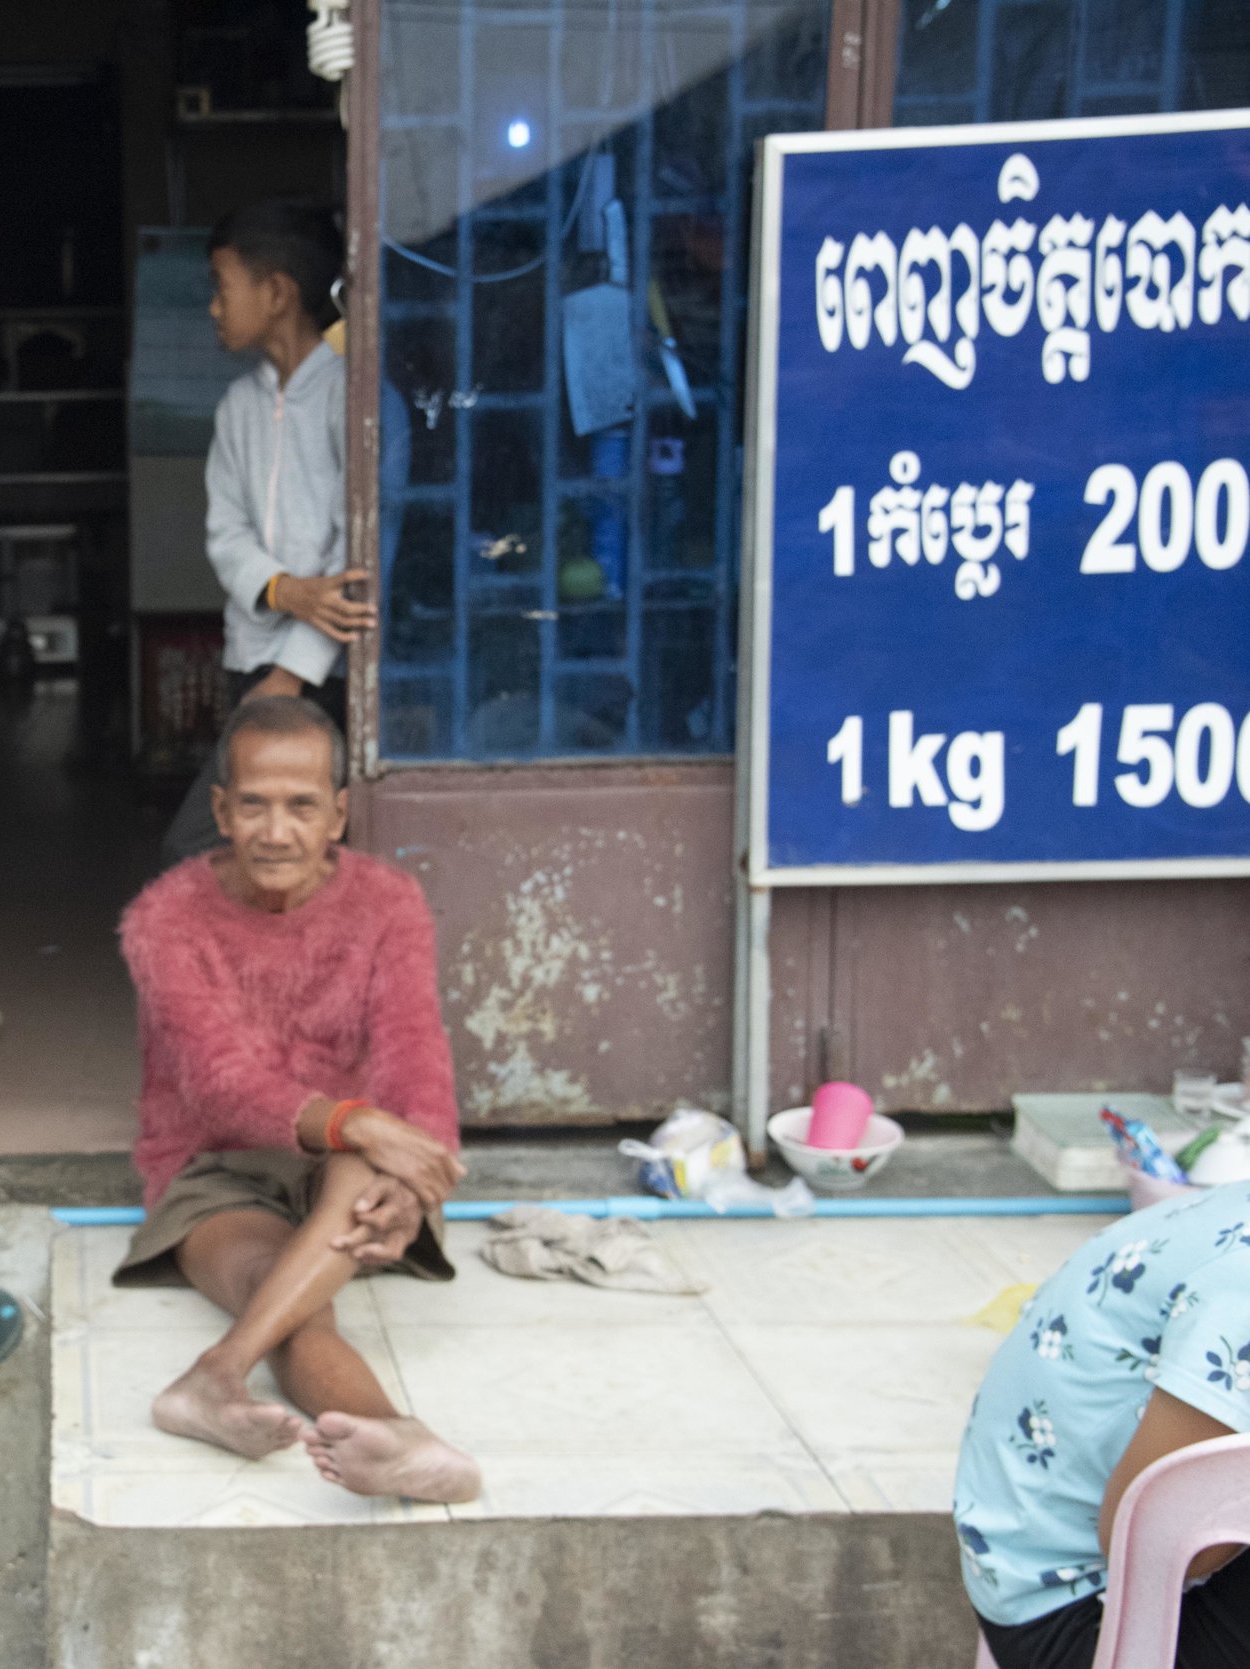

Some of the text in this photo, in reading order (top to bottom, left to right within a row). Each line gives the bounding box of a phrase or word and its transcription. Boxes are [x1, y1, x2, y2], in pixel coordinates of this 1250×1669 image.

[1080, 458, 1250, 574] 200
[827, 702, 1250, 832] 1 kg 150
